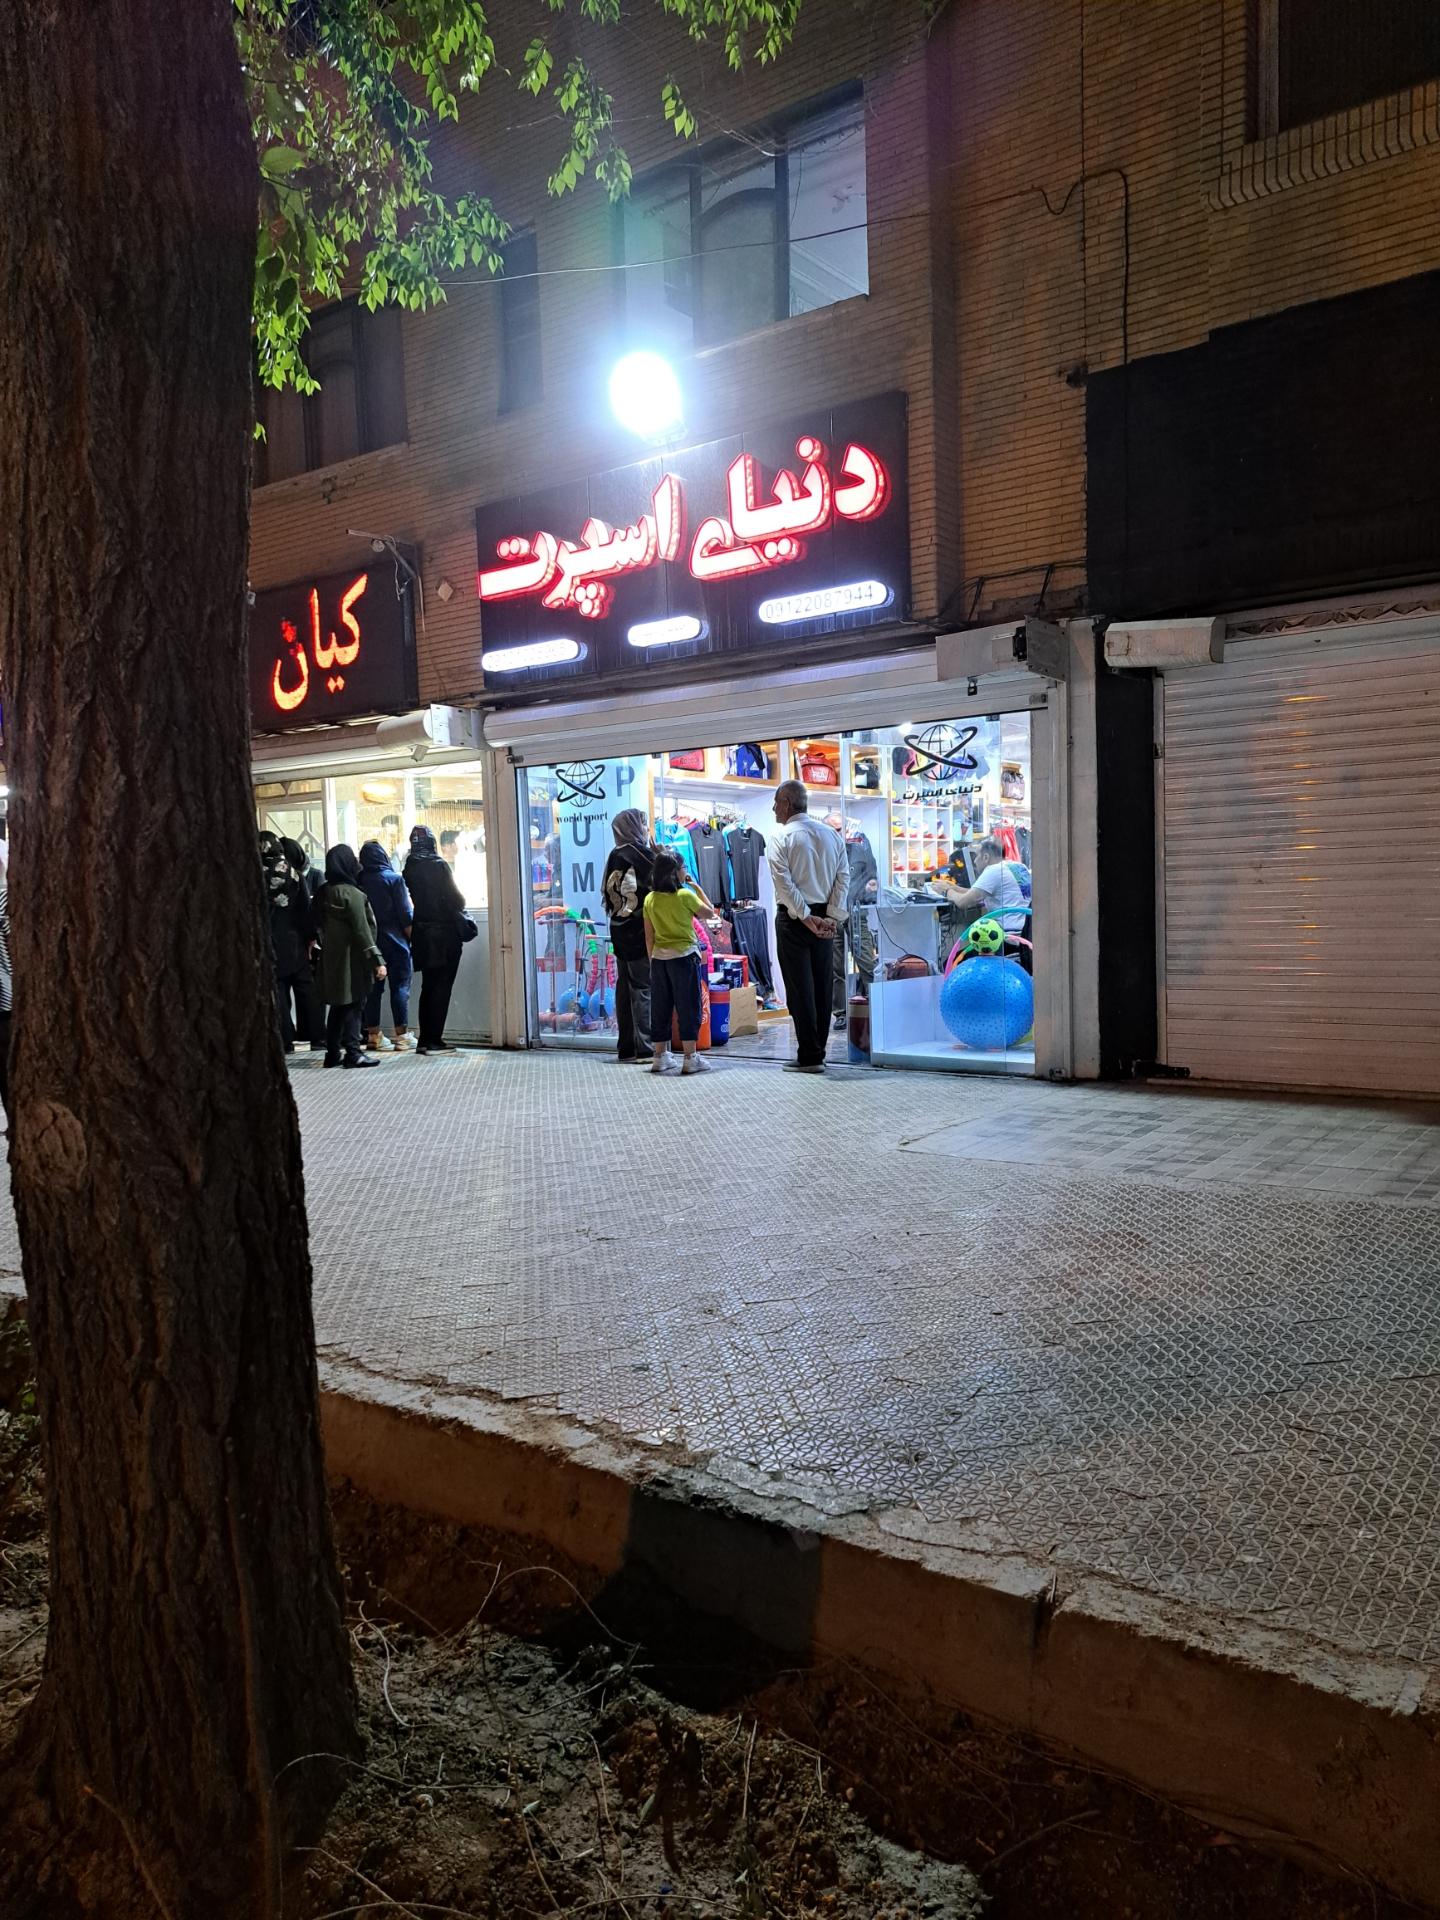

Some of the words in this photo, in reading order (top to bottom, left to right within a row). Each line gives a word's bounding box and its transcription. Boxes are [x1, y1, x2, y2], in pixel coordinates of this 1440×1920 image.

[479, 472, 686, 618] اسپرت
[689, 435, 888, 579] دنیای
[272, 573, 368, 710] کیان
[765, 584, 873, 619] 09122087944
